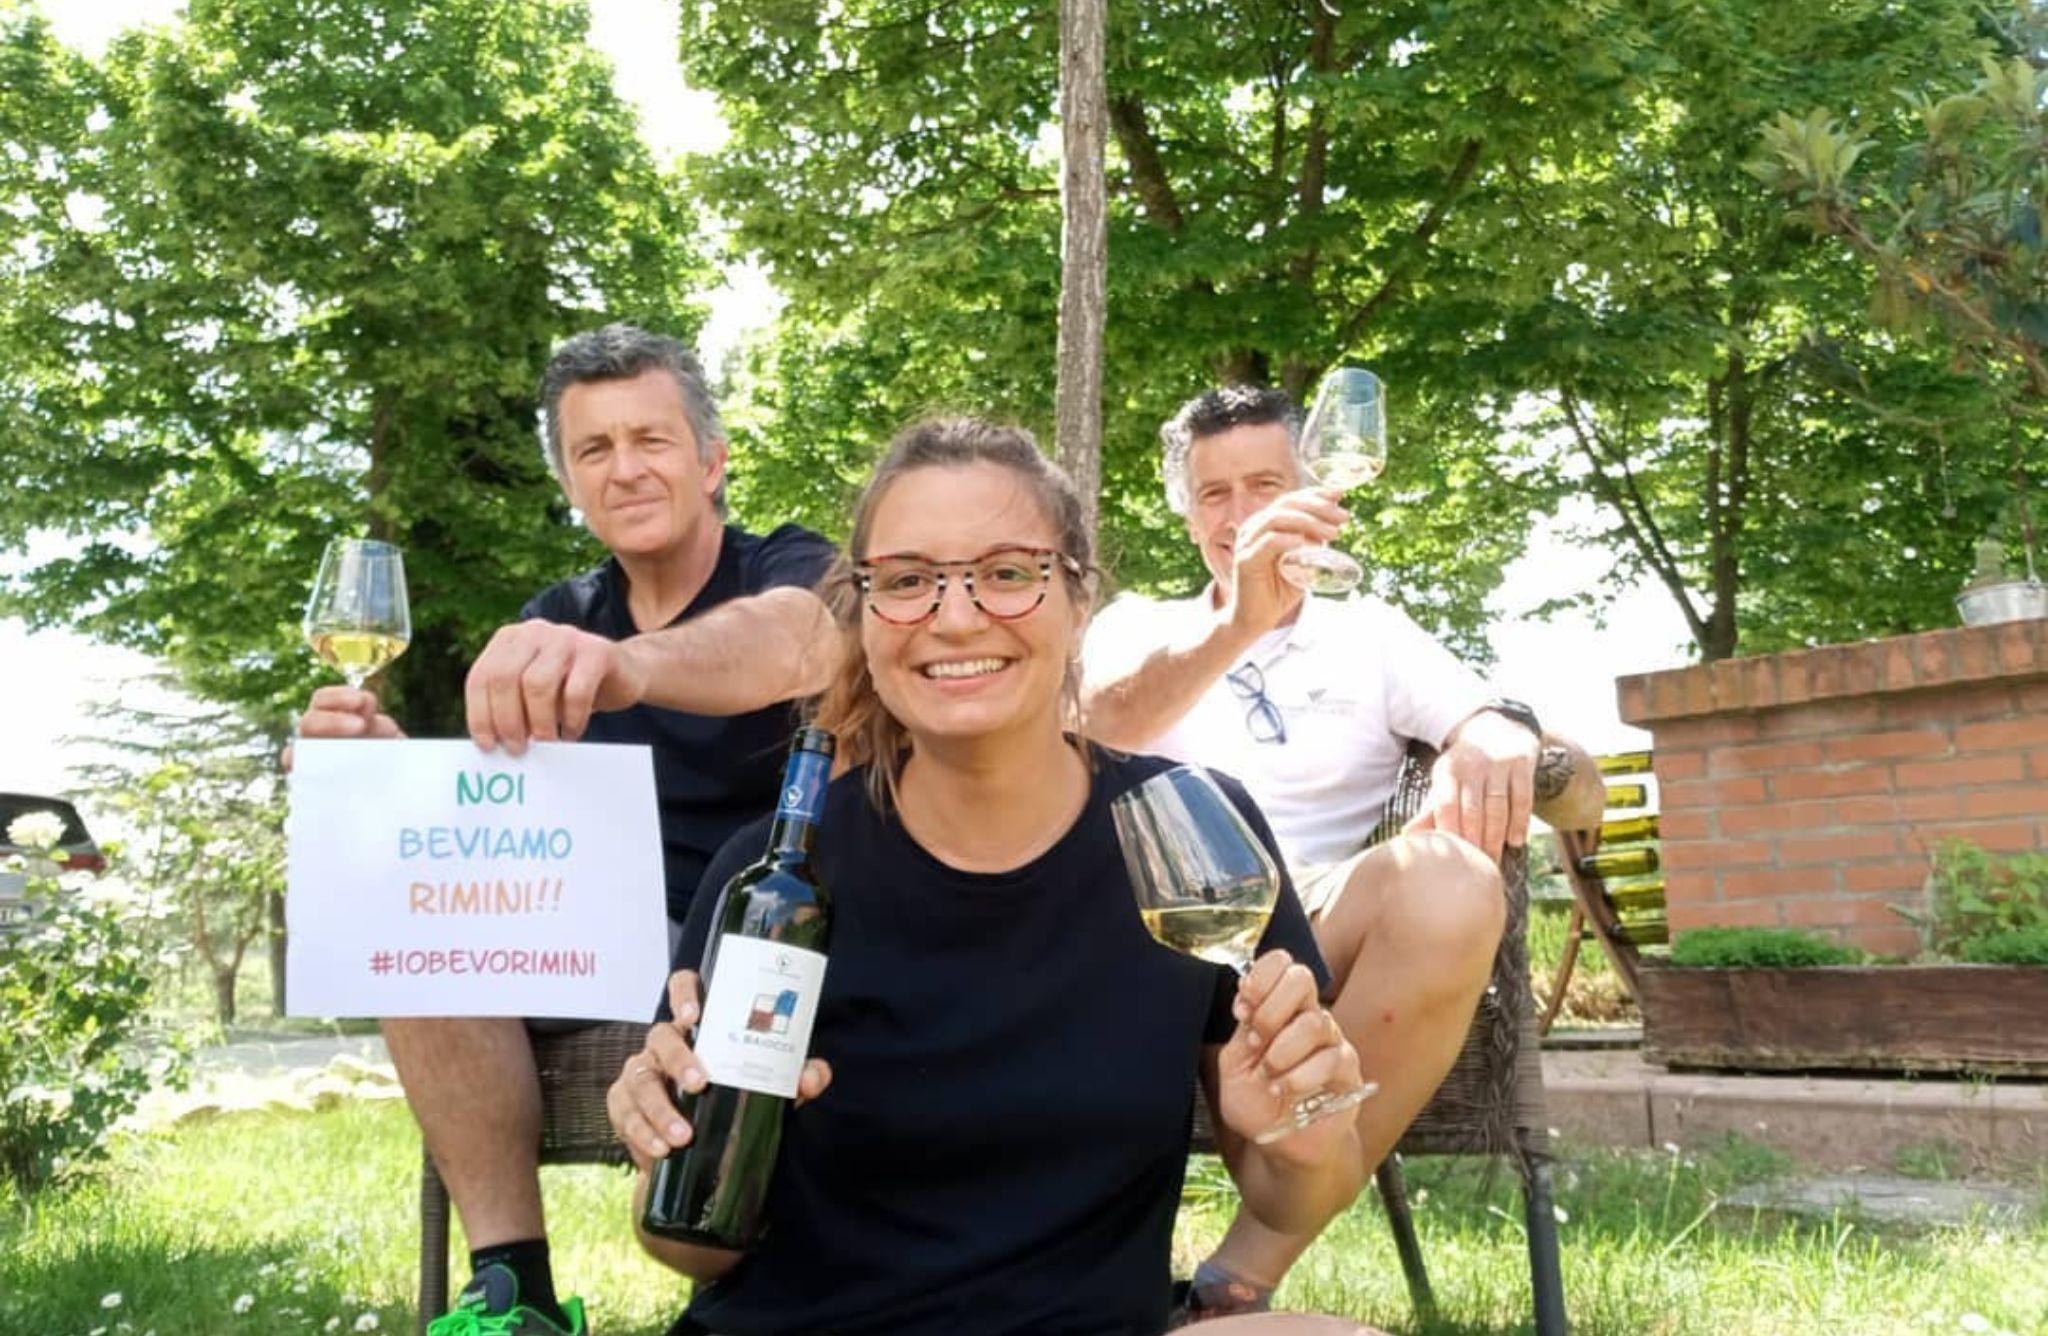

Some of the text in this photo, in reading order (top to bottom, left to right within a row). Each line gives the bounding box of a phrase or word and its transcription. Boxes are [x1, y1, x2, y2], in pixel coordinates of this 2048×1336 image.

[456, 771, 525, 805] NOI
[399, 827, 573, 860] BEVIAMO
[409, 877, 563, 914] RIMINI!!
[369, 949, 596, 977] #IOBEVORIMINI
